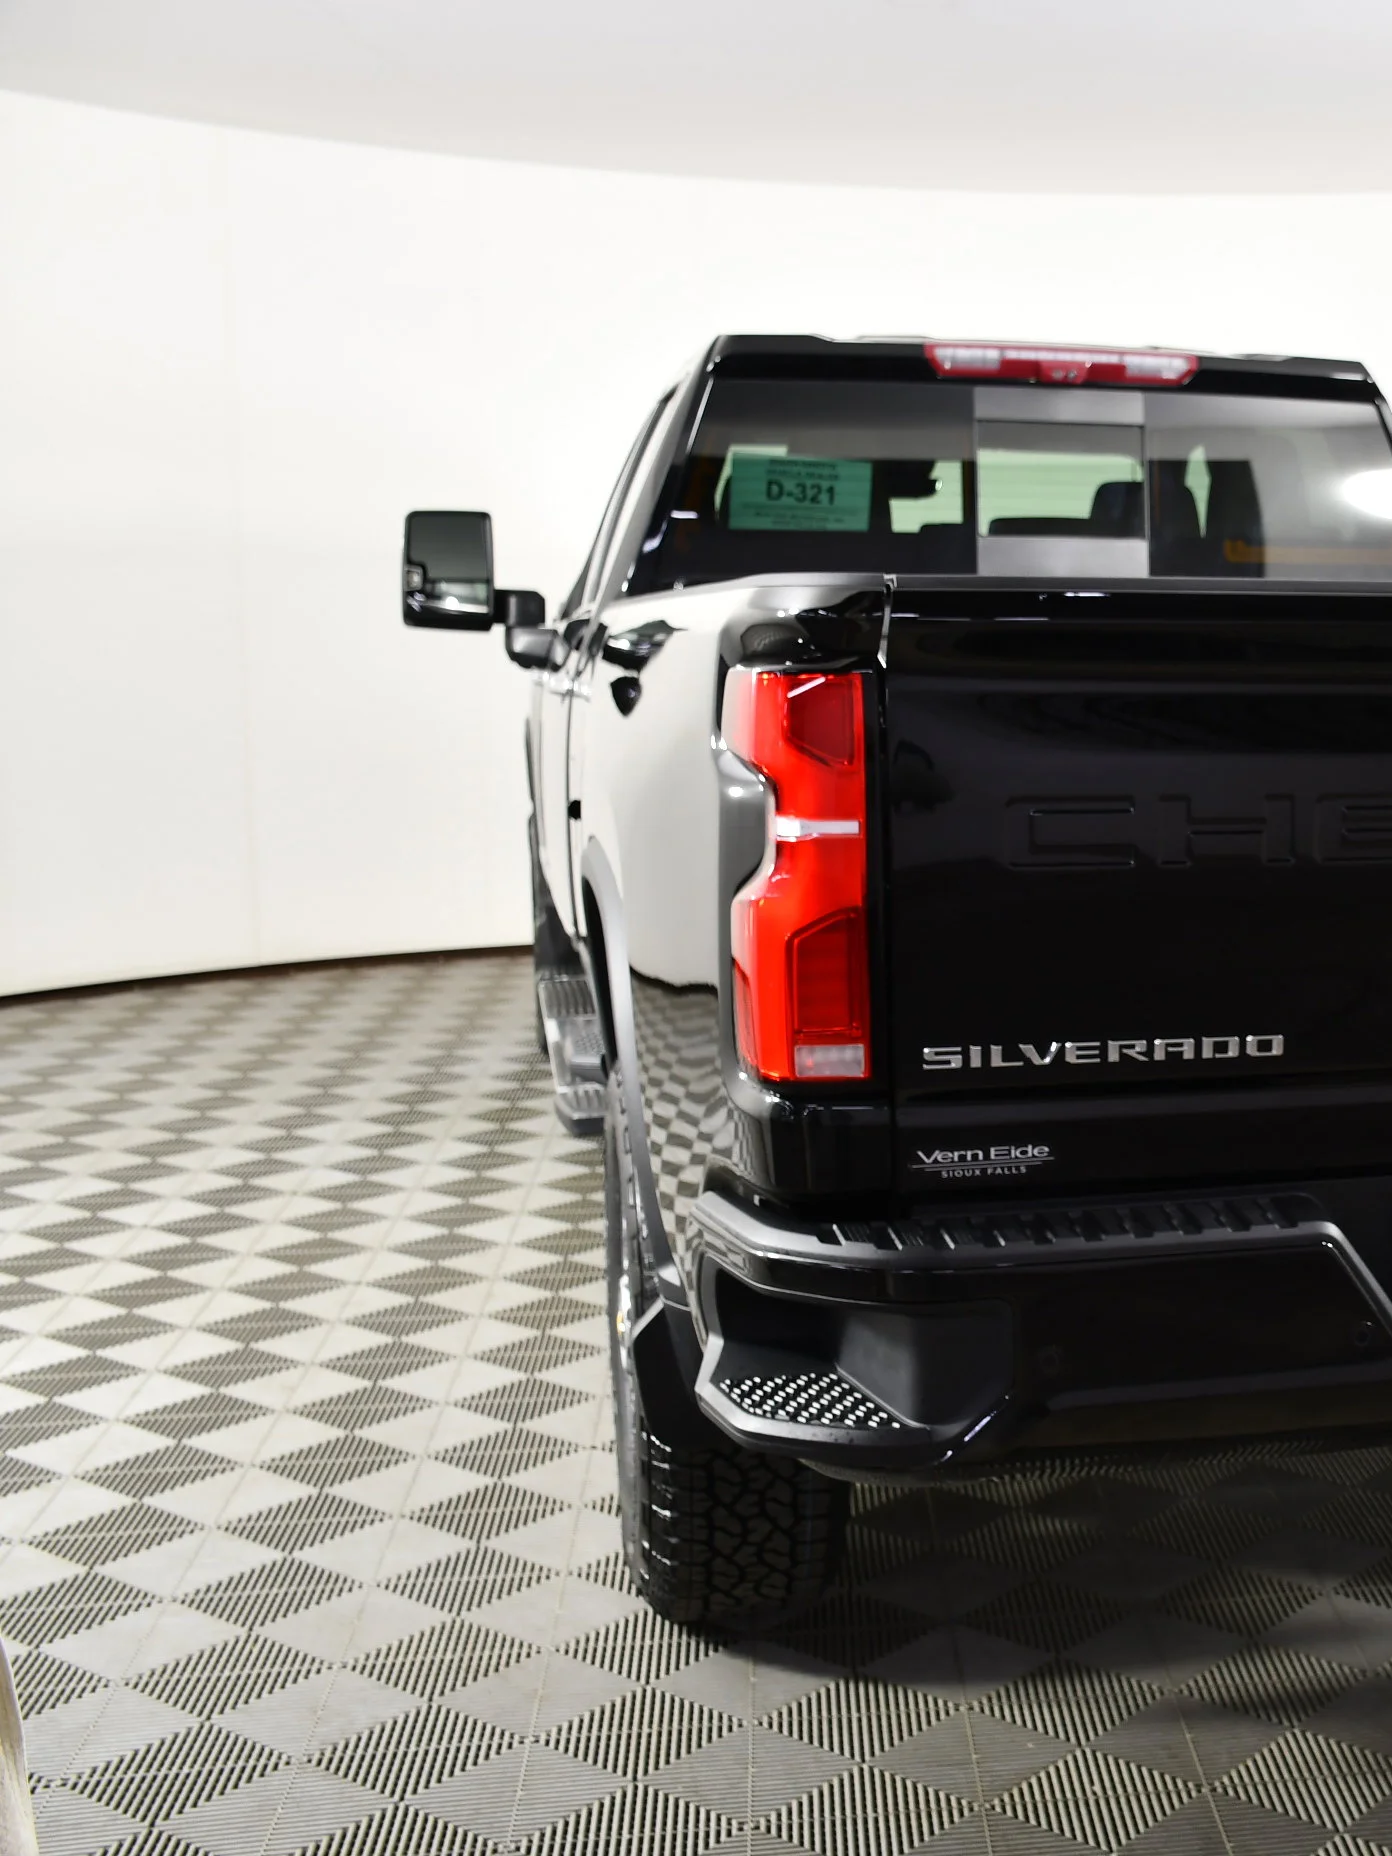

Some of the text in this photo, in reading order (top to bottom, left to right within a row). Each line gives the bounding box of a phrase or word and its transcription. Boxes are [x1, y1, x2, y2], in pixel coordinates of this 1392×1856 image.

[765, 479, 836, 506] D-321
[922, 1034, 1284, 1070] SILVERADO
[916, 1144, 1050, 1164] Vern Eide
[941, 1165, 1027, 1179] SIOUX FALLS
